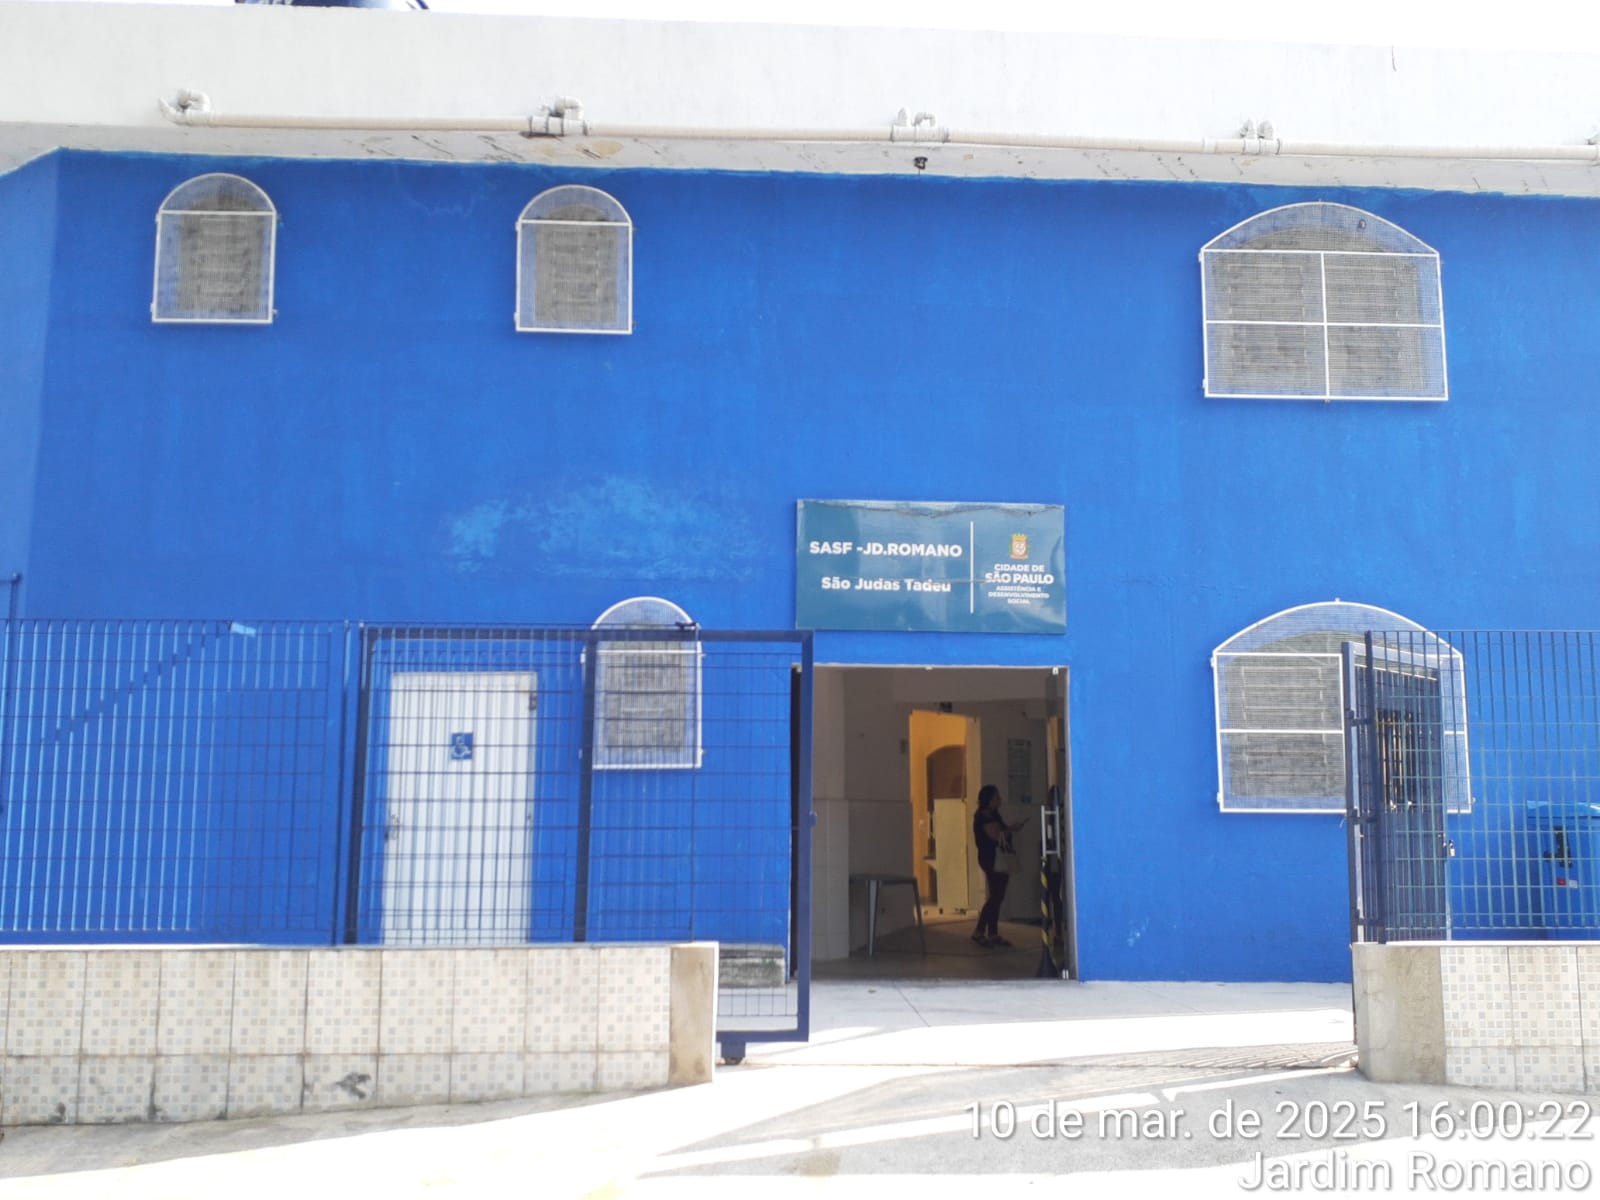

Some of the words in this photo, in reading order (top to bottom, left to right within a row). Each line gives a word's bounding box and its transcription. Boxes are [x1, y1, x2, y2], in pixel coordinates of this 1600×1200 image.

[809, 541, 853, 555] SASF
[994, 563, 1030, 572] CIDADE
[1031, 564, 1045, 573] DE
[821, 577, 851, 590] São
[854, 578, 901, 592] Judas
[904, 578, 951, 593] Tadeu
[985, 571, 1011, 584] SÃO
[1013, 573, 1055, 585] PAULO
